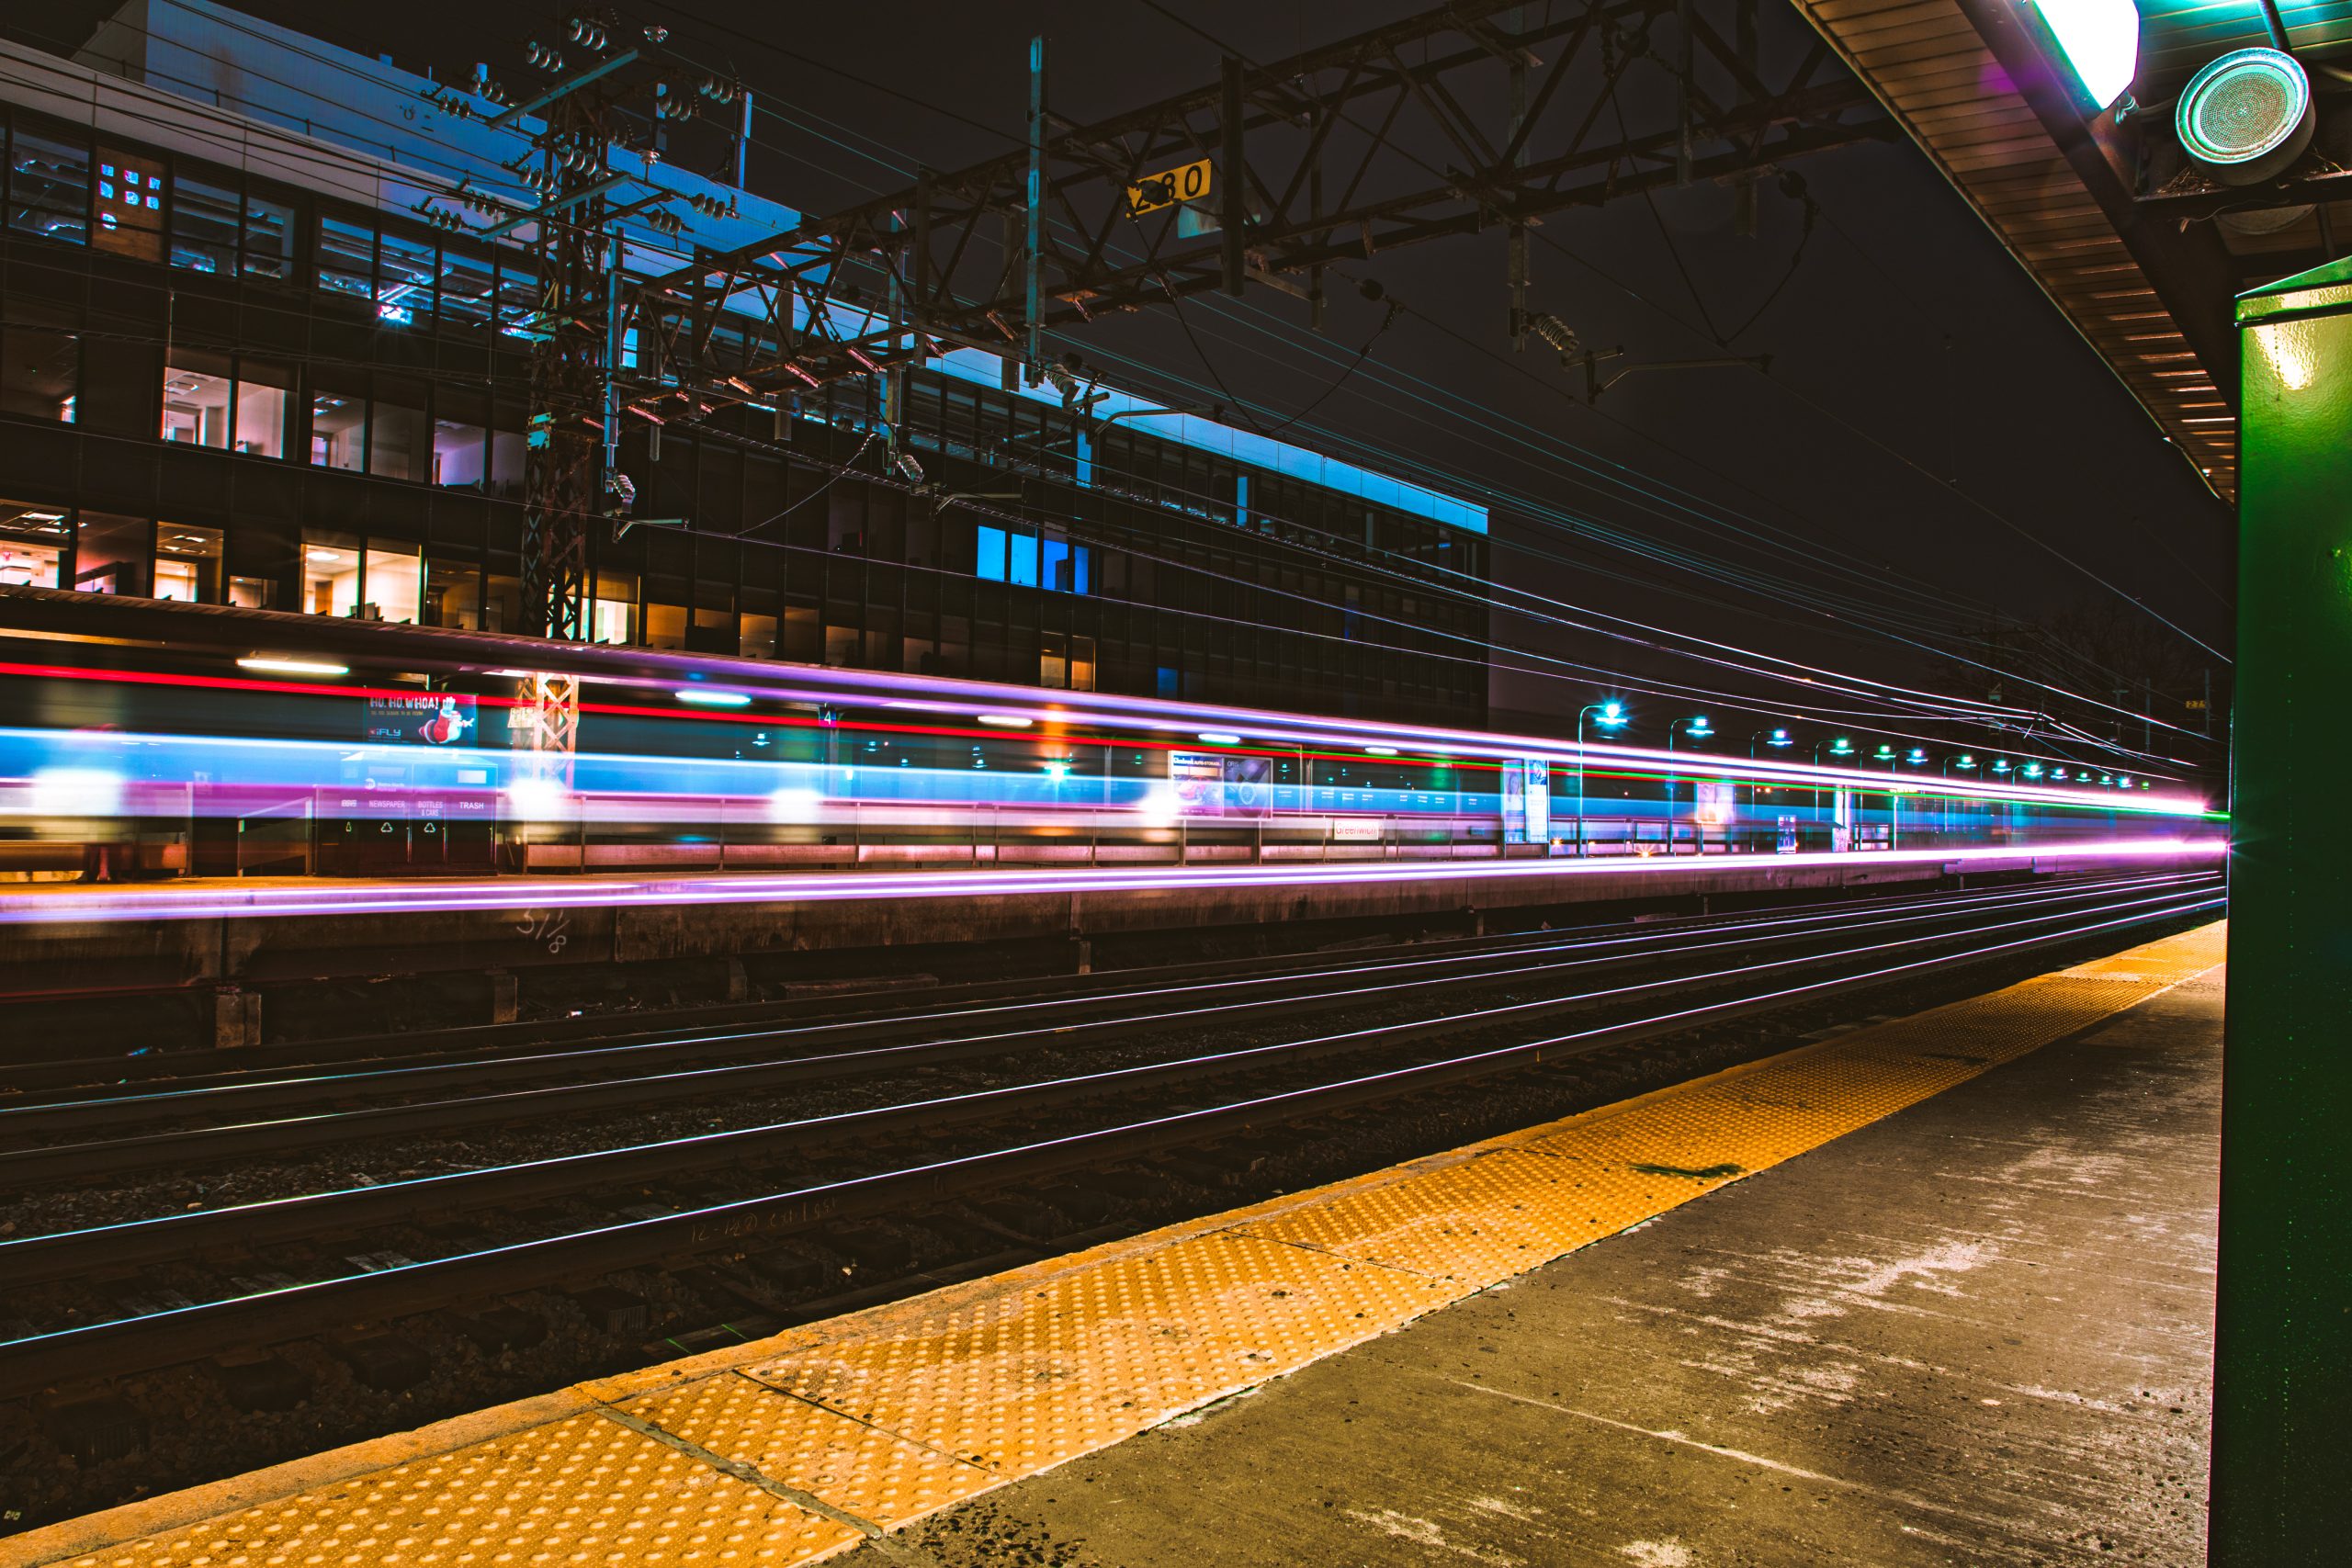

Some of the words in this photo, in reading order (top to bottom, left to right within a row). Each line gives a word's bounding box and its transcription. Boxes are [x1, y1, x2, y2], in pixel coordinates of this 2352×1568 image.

[405, 696, 439, 709] WHOA!
[821, 710, 831, 725] 4
[458, 802, 484, 810] TRASH
[1336, 823, 1376, 835] Greenwich
